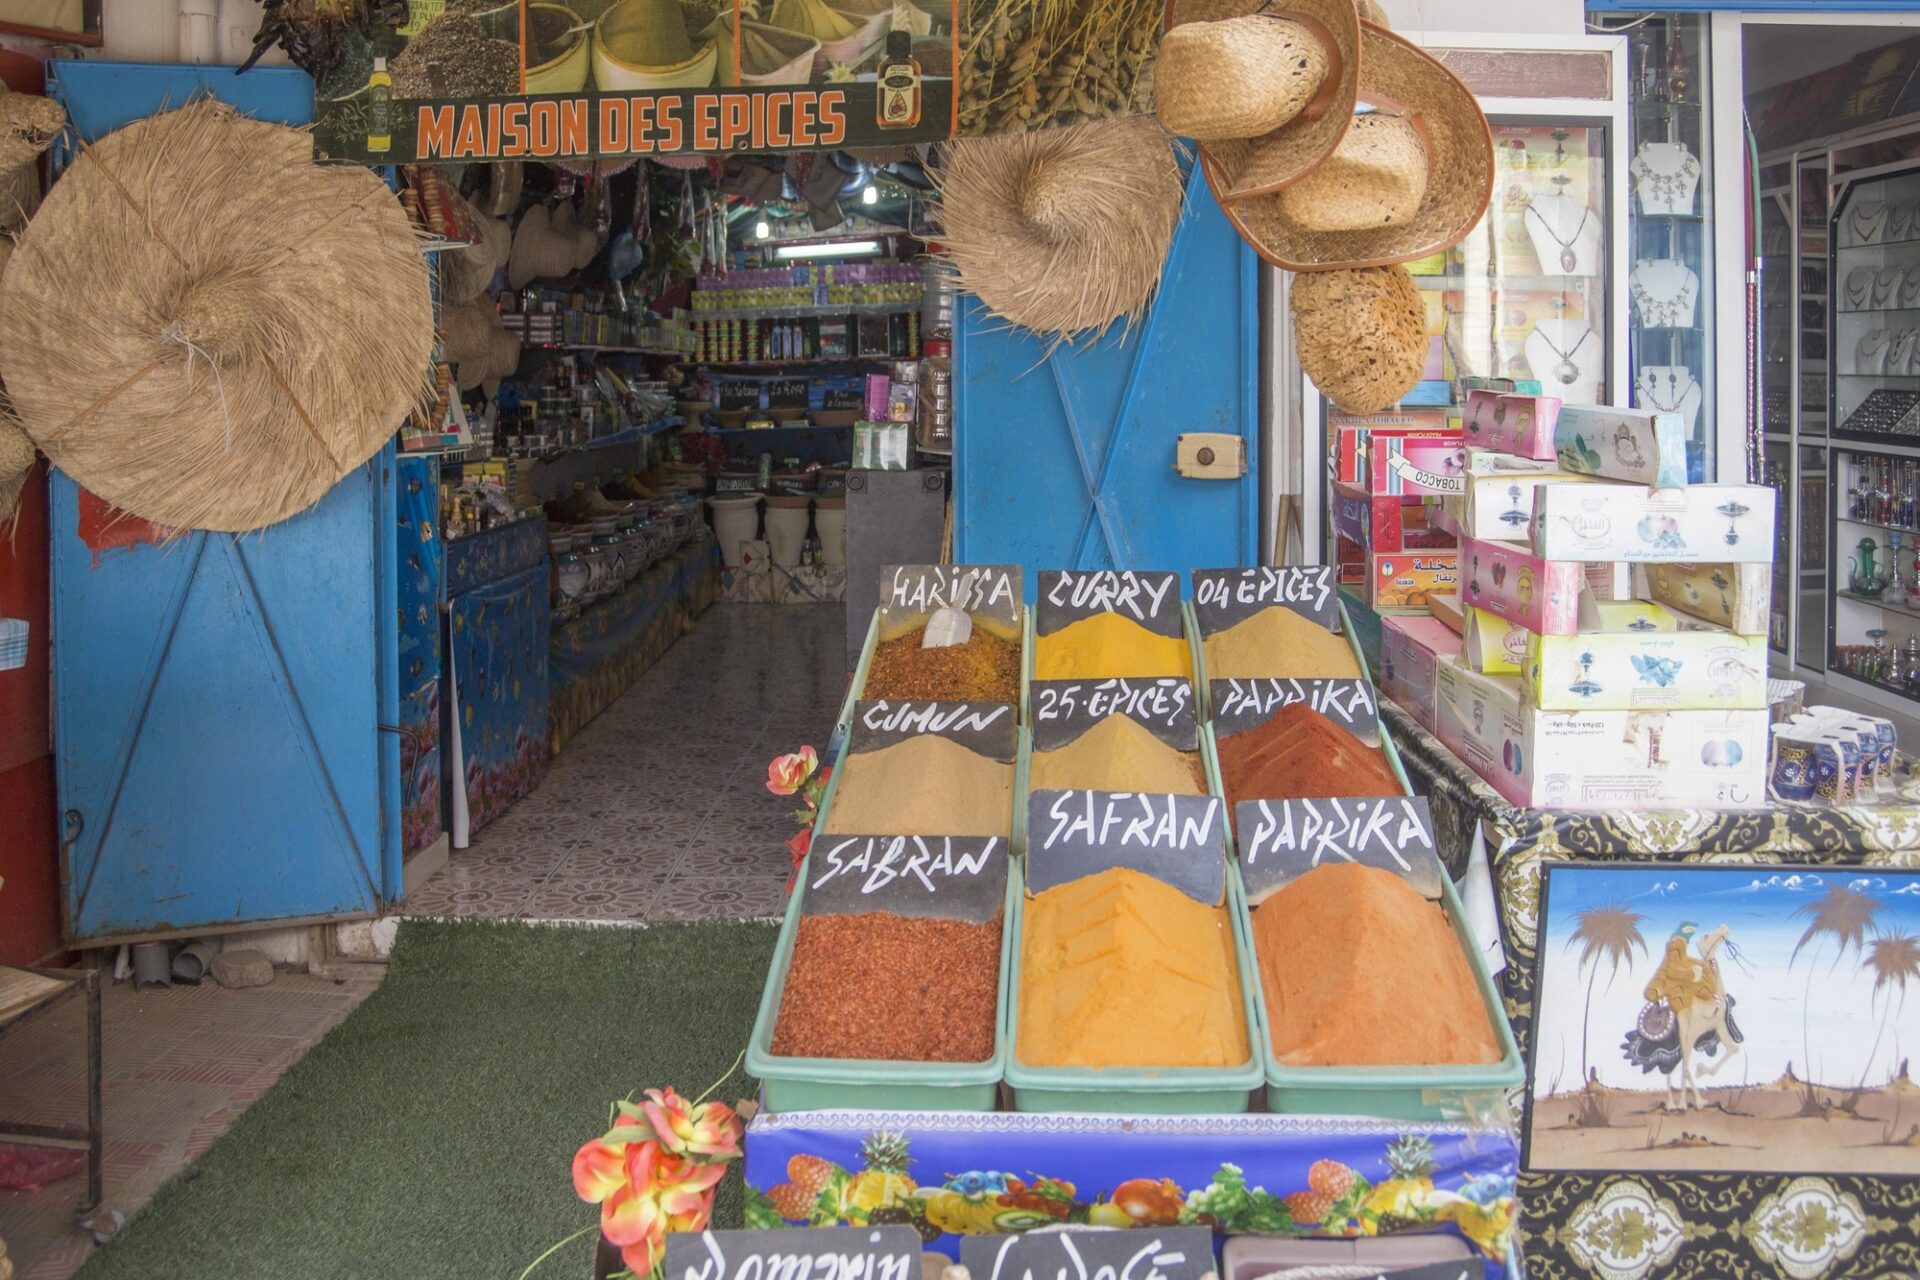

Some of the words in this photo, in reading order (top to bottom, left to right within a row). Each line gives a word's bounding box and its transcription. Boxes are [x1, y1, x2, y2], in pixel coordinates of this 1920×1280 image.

[416, 99, 588, 158] MAISON
[600, 96, 682, 153] DES
[694, 90, 846, 150] EPICES
[1373, 415, 1415, 424] TOBACCO
[1415, 470, 1461, 490] TOBACCO
[1048, 570, 1174, 621] CURRY
[1198, 578, 1227, 609] 04
[1043, 790, 1218, 849] SAFRAN
